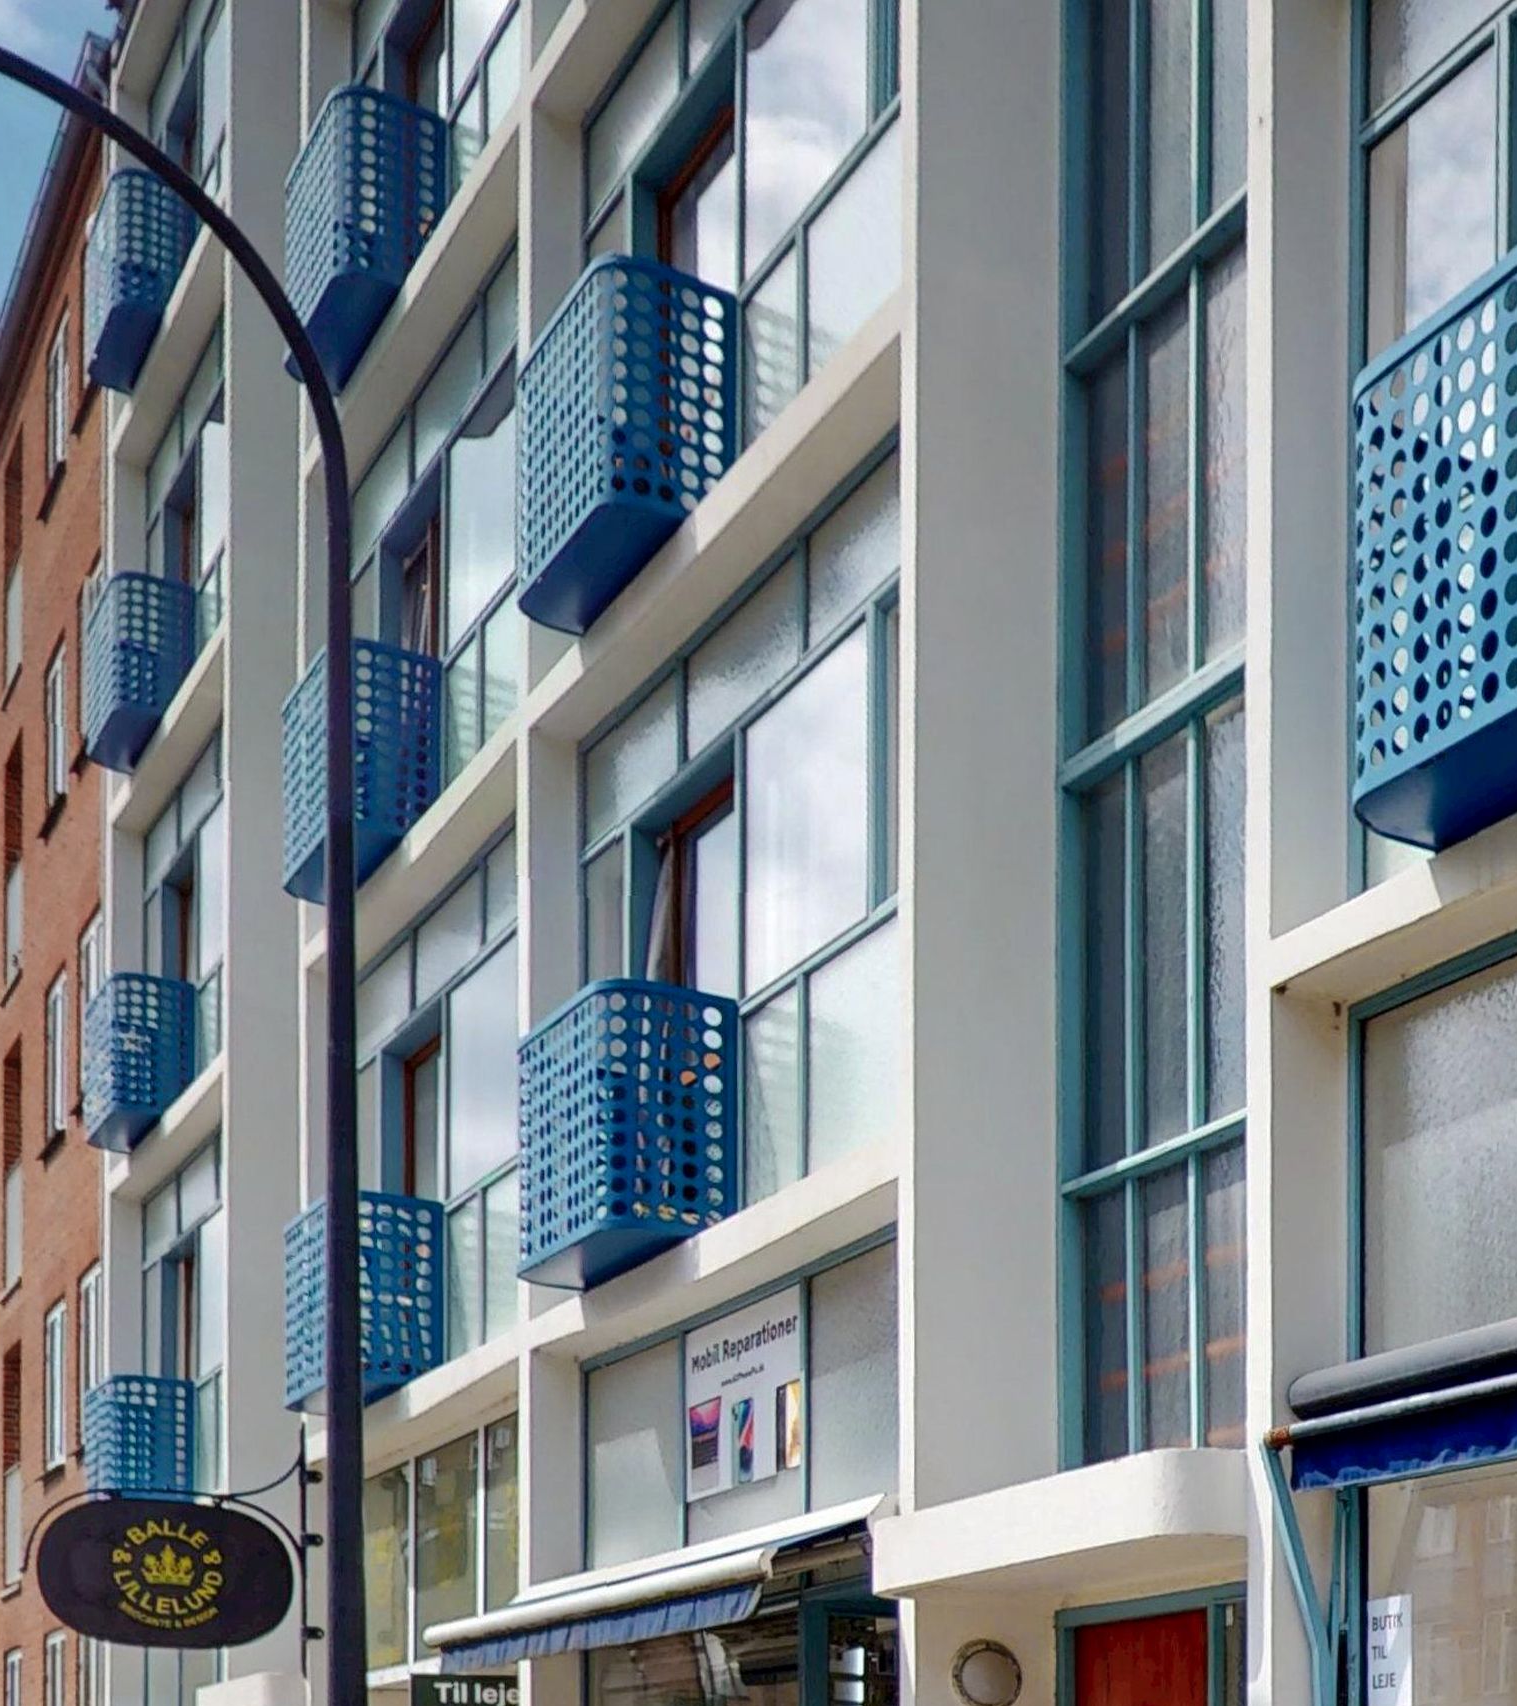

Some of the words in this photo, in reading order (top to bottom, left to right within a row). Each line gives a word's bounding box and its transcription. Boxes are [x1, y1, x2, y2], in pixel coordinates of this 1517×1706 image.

[691, 1343, 720, 1374] Mobil
[723, 1315, 798, 1362] Reparationer
[126, 1518, 209, 1549] BALLE
[113, 1570, 223, 1615] LILLELUND
[1372, 1612, 1403, 1632] BUTIK
[1372, 1645, 1388, 1660] TIL
[433, 1681, 468, 1704] Til
[1372, 1672, 1397, 1690] LEJE
